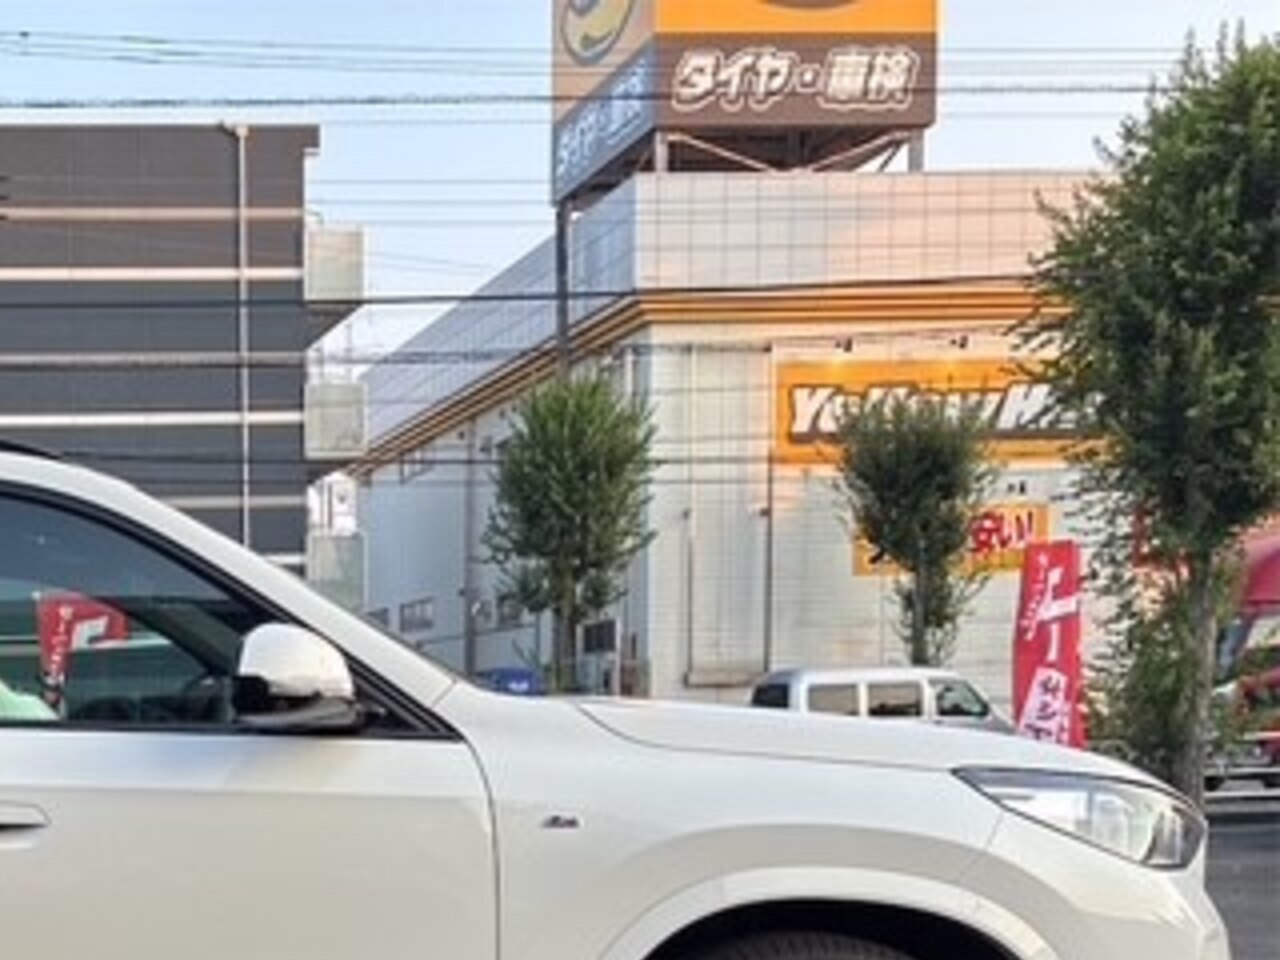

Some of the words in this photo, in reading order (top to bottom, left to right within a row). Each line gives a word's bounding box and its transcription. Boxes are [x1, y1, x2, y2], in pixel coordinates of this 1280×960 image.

[673, 48, 918, 111] タイヤ・車検
